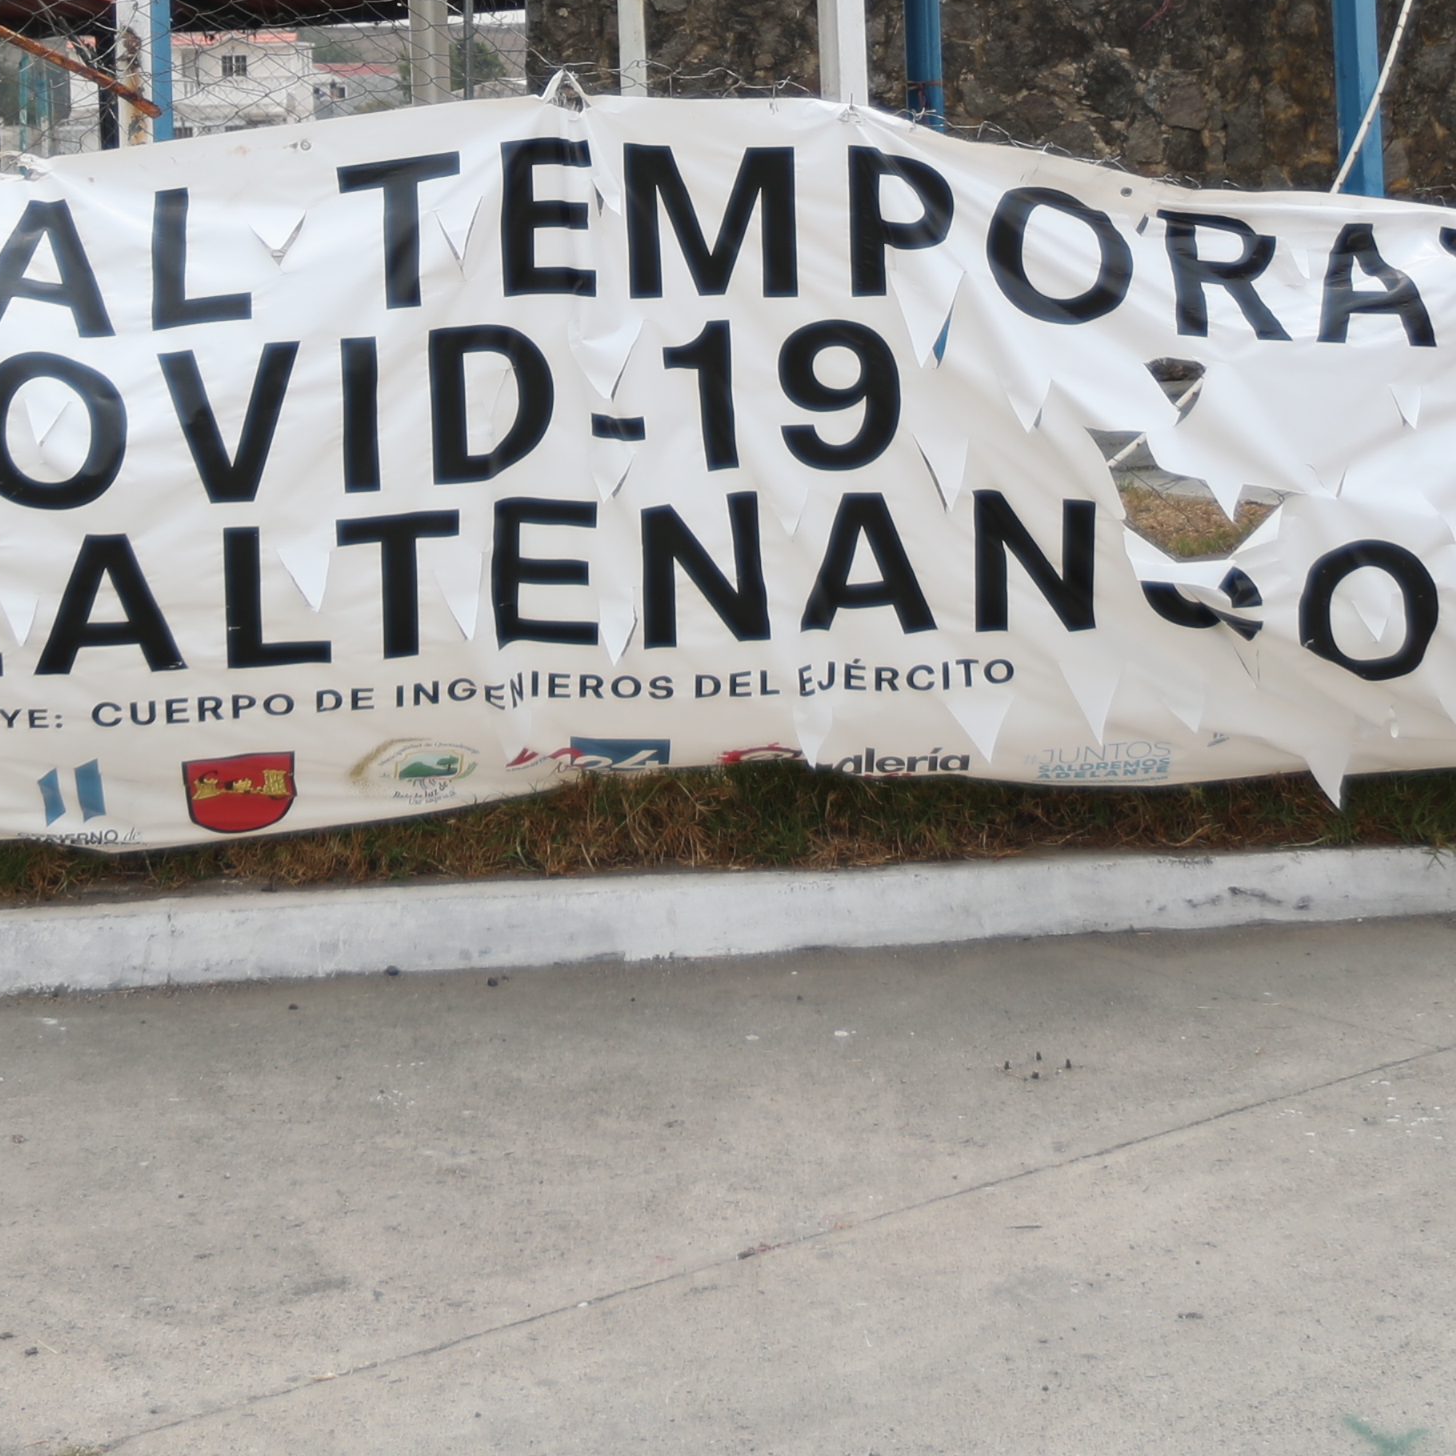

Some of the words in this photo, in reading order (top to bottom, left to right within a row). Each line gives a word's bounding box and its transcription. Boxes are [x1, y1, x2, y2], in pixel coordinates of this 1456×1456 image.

[91, 693, 295, 728] CUERPO
[316, 687, 375, 713] DE
[395, 670, 675, 710] INGENIEROS
[694, 670, 780, 700] DEL
[798, 658, 1015, 699] EJÉRCITO
[1023, 740, 1172, 766] #JUNTOS
[1035, 765, 1169, 780] ADELANTE
[1038, 757, 1171, 773] SALDREMOS
